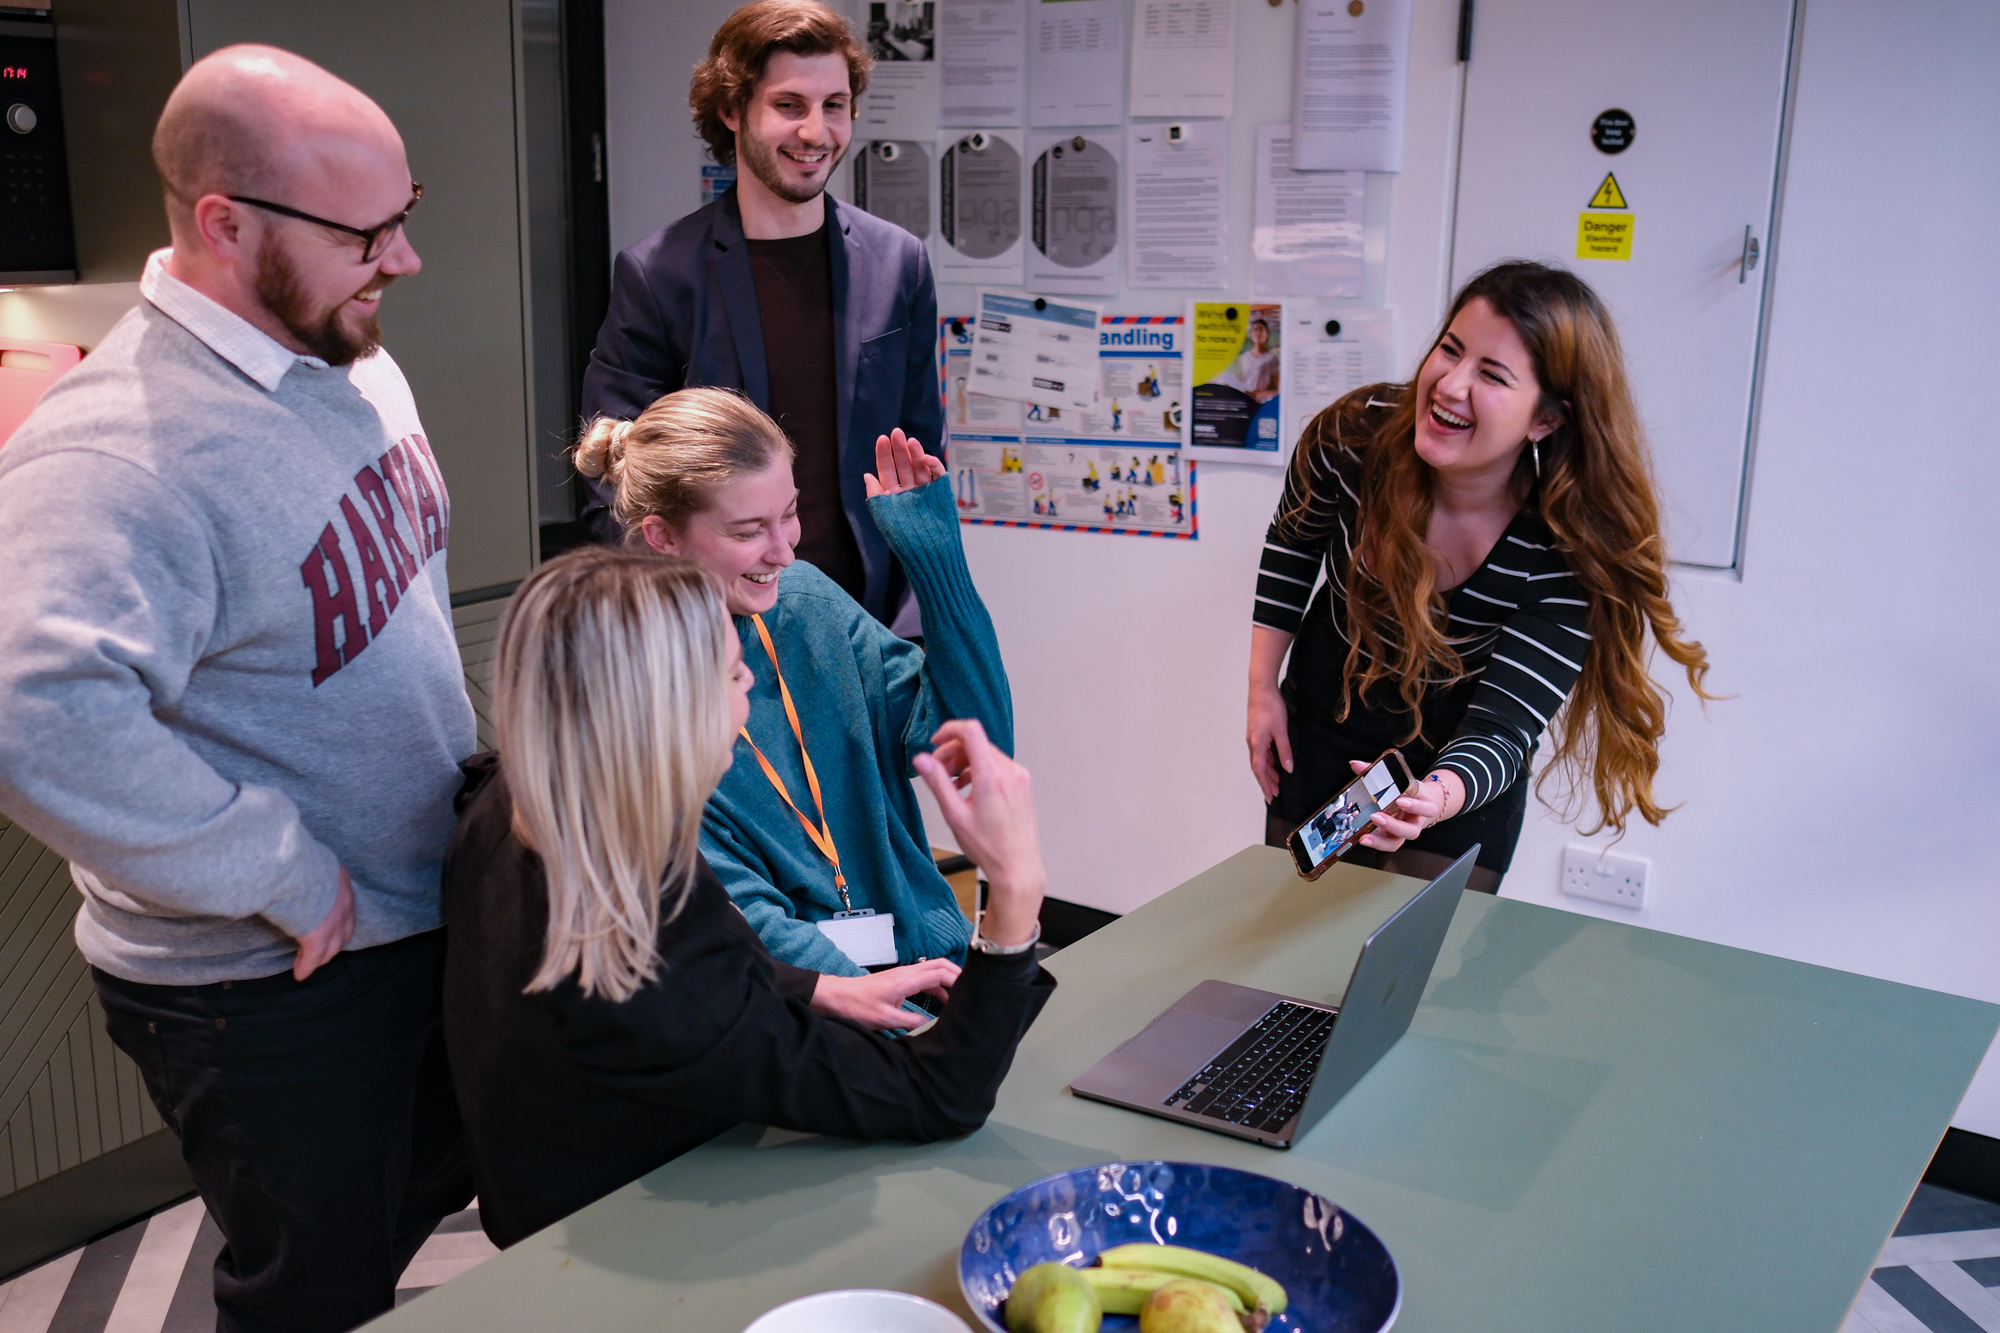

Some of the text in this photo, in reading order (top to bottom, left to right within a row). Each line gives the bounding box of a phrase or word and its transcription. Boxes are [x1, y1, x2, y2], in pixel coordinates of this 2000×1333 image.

[1584, 221, 1628, 235] Danger
[1586, 235, 1623, 243] Electrical
[1591, 245, 1619, 253] hazard
[1100, 329, 1174, 350] andling
